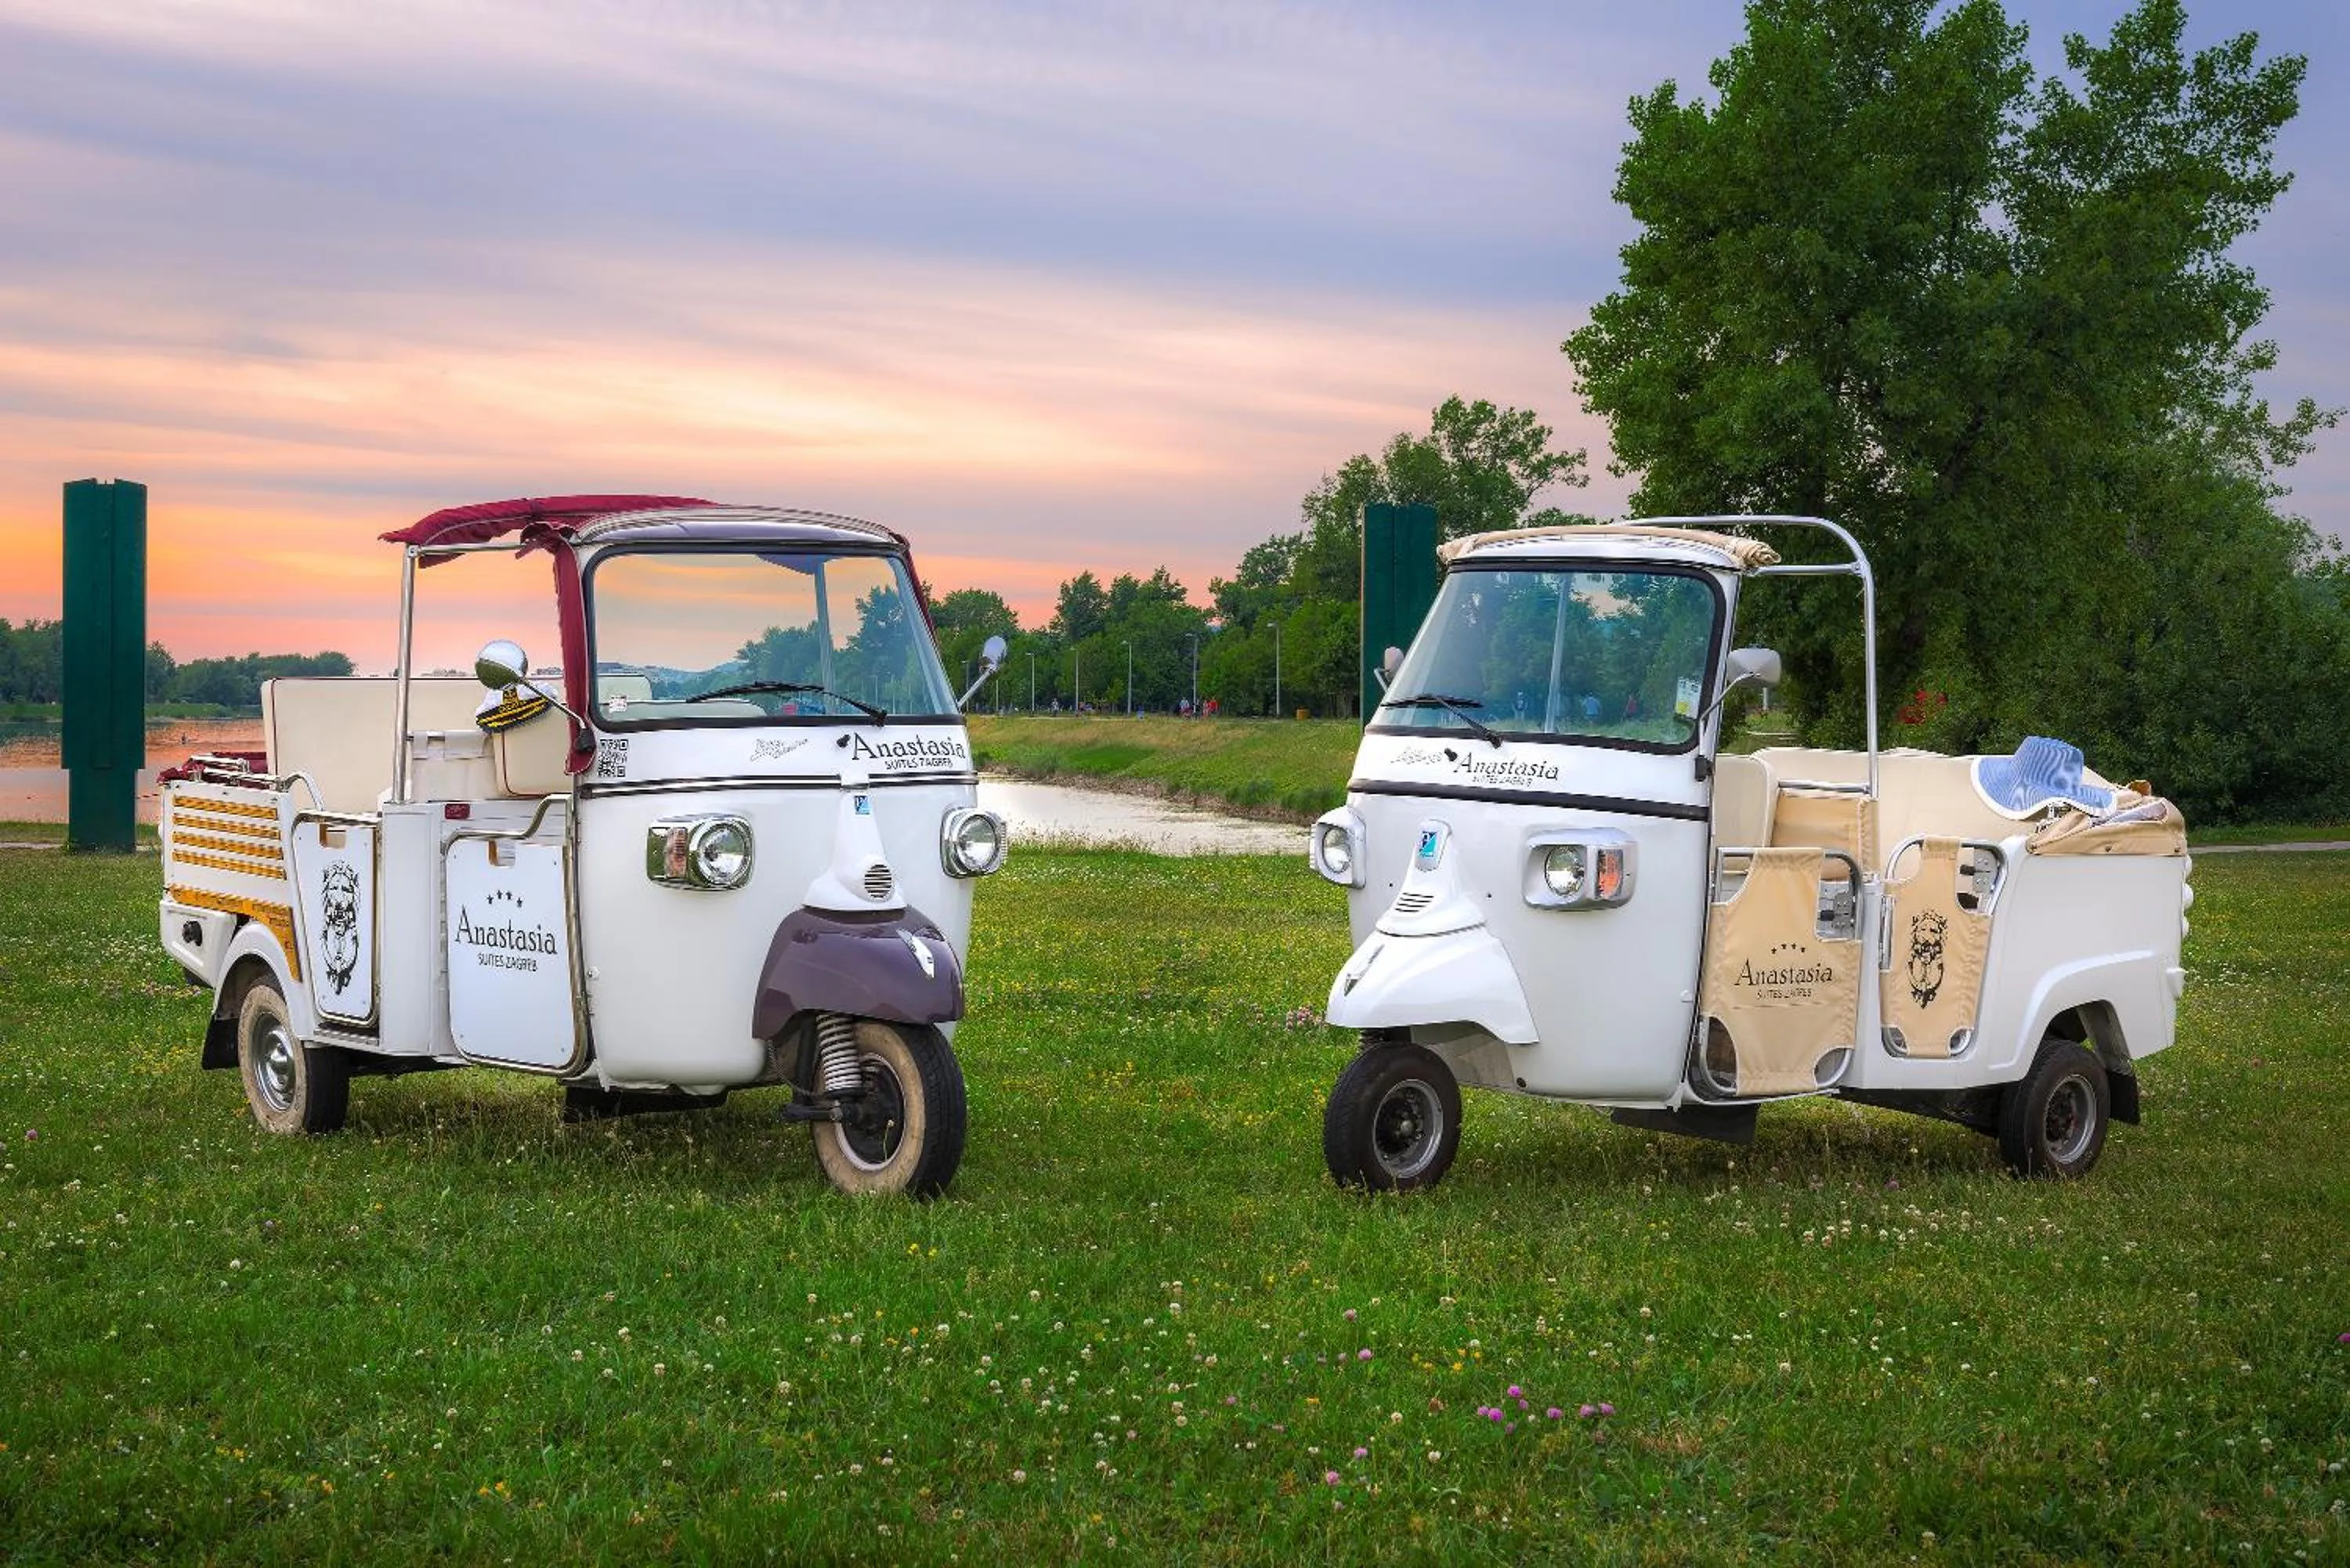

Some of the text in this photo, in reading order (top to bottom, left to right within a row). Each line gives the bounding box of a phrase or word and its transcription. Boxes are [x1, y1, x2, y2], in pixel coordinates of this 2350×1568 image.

[852, 732, 965, 760] Anastasia
[885, 758, 917, 770] SUITES
[1453, 752, 1559, 781] Anastasia
[454, 905, 558, 955] Anastasia
[478, 952, 538, 972] SUITES ZAGREB
[1734, 958, 1833, 986] Anastasia
